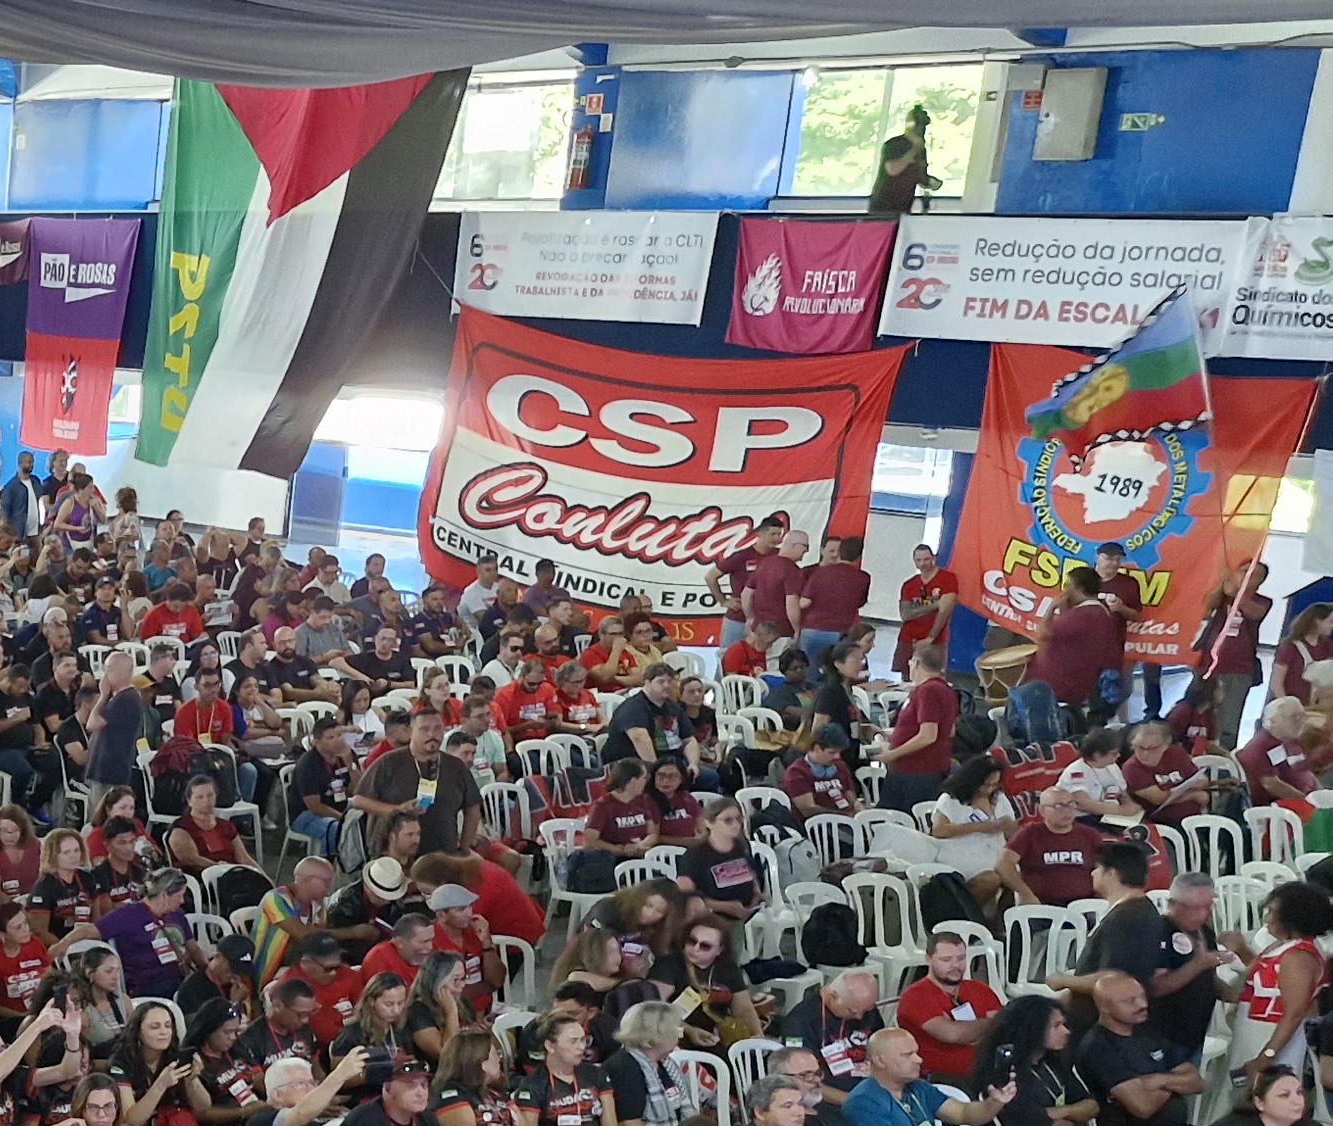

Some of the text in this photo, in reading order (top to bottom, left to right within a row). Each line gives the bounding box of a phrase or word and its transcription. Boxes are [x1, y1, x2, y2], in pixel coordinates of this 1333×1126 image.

[901, 242, 928, 272] 6
[973, 237, 1226, 265] Redução da jornada,
[43, 257, 117, 286] PÃO E ROSAS
[968, 266, 1223, 291] sem redução salarial
[962, 296, 1143, 327] FIM DA ESCAL
[158, 250, 212, 434] PSTU
[485, 373, 825, 474] CSP
[1093, 472, 1144, 499] 1989
[458, 461, 791, 568] Conluta
[1043, 850, 1084, 865] MPR
